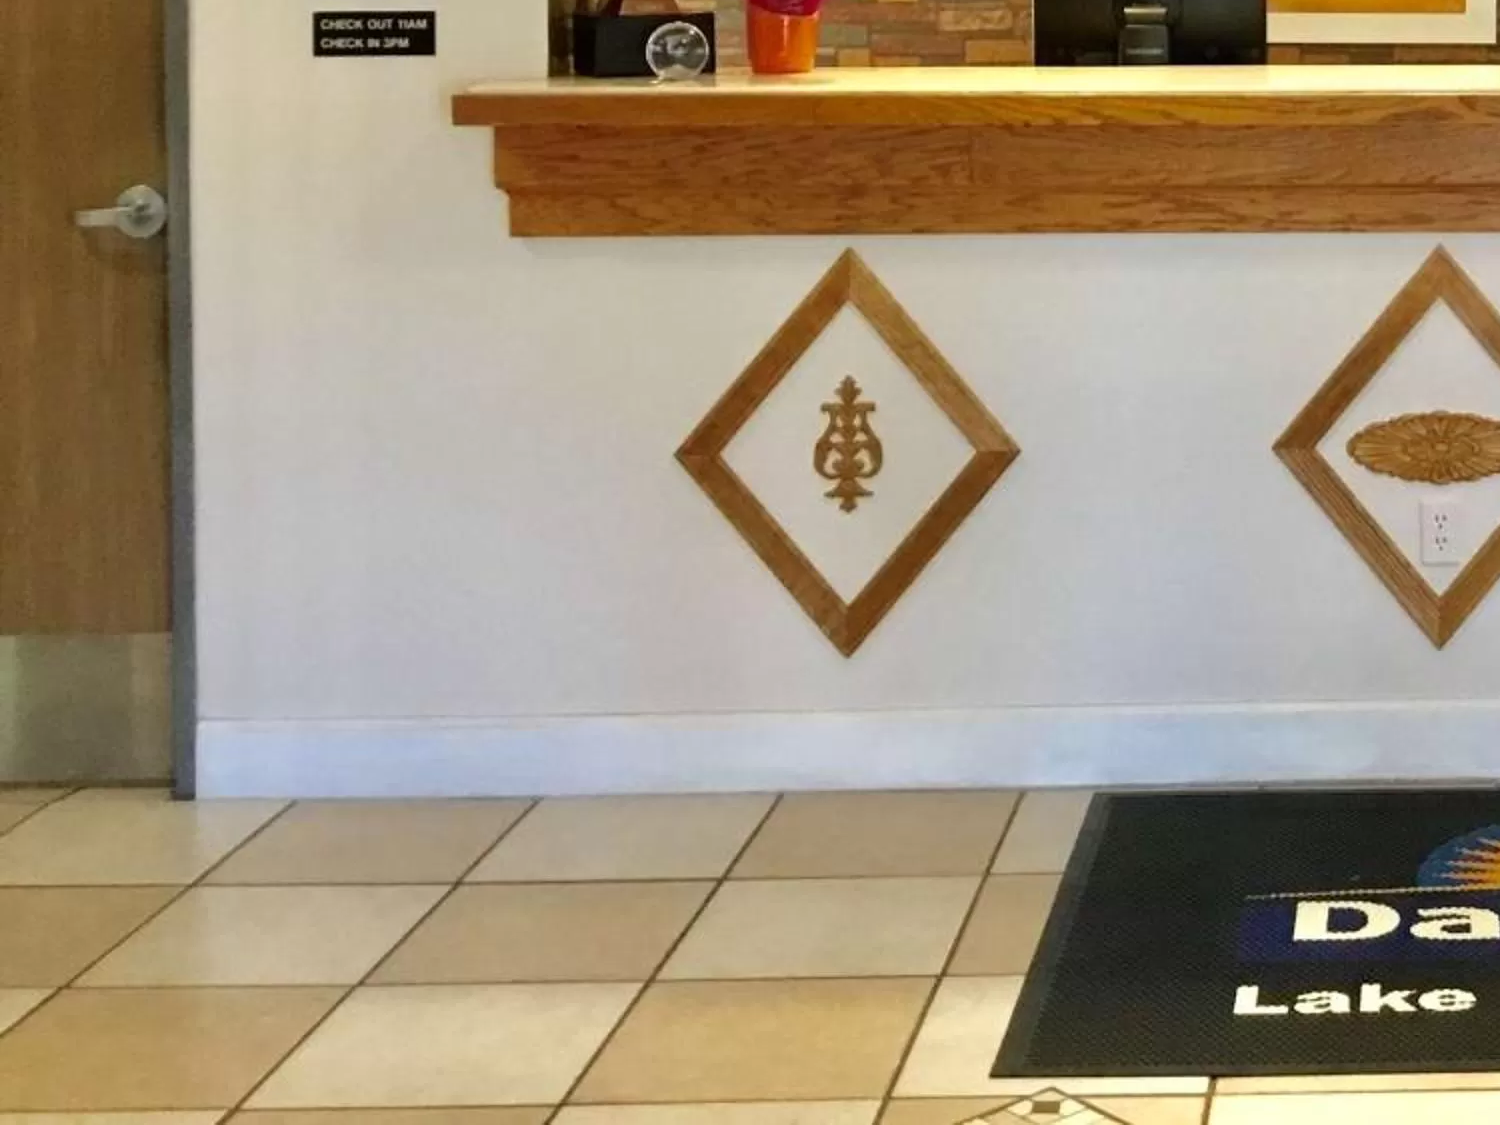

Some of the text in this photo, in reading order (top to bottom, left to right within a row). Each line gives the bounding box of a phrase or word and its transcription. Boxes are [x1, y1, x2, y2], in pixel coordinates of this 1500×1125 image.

[320, 18, 428, 30] CHECK OUT 11AM
[320, 37, 410, 49] CHECK IN 3PM
[1233, 983, 1478, 1017] Lake
